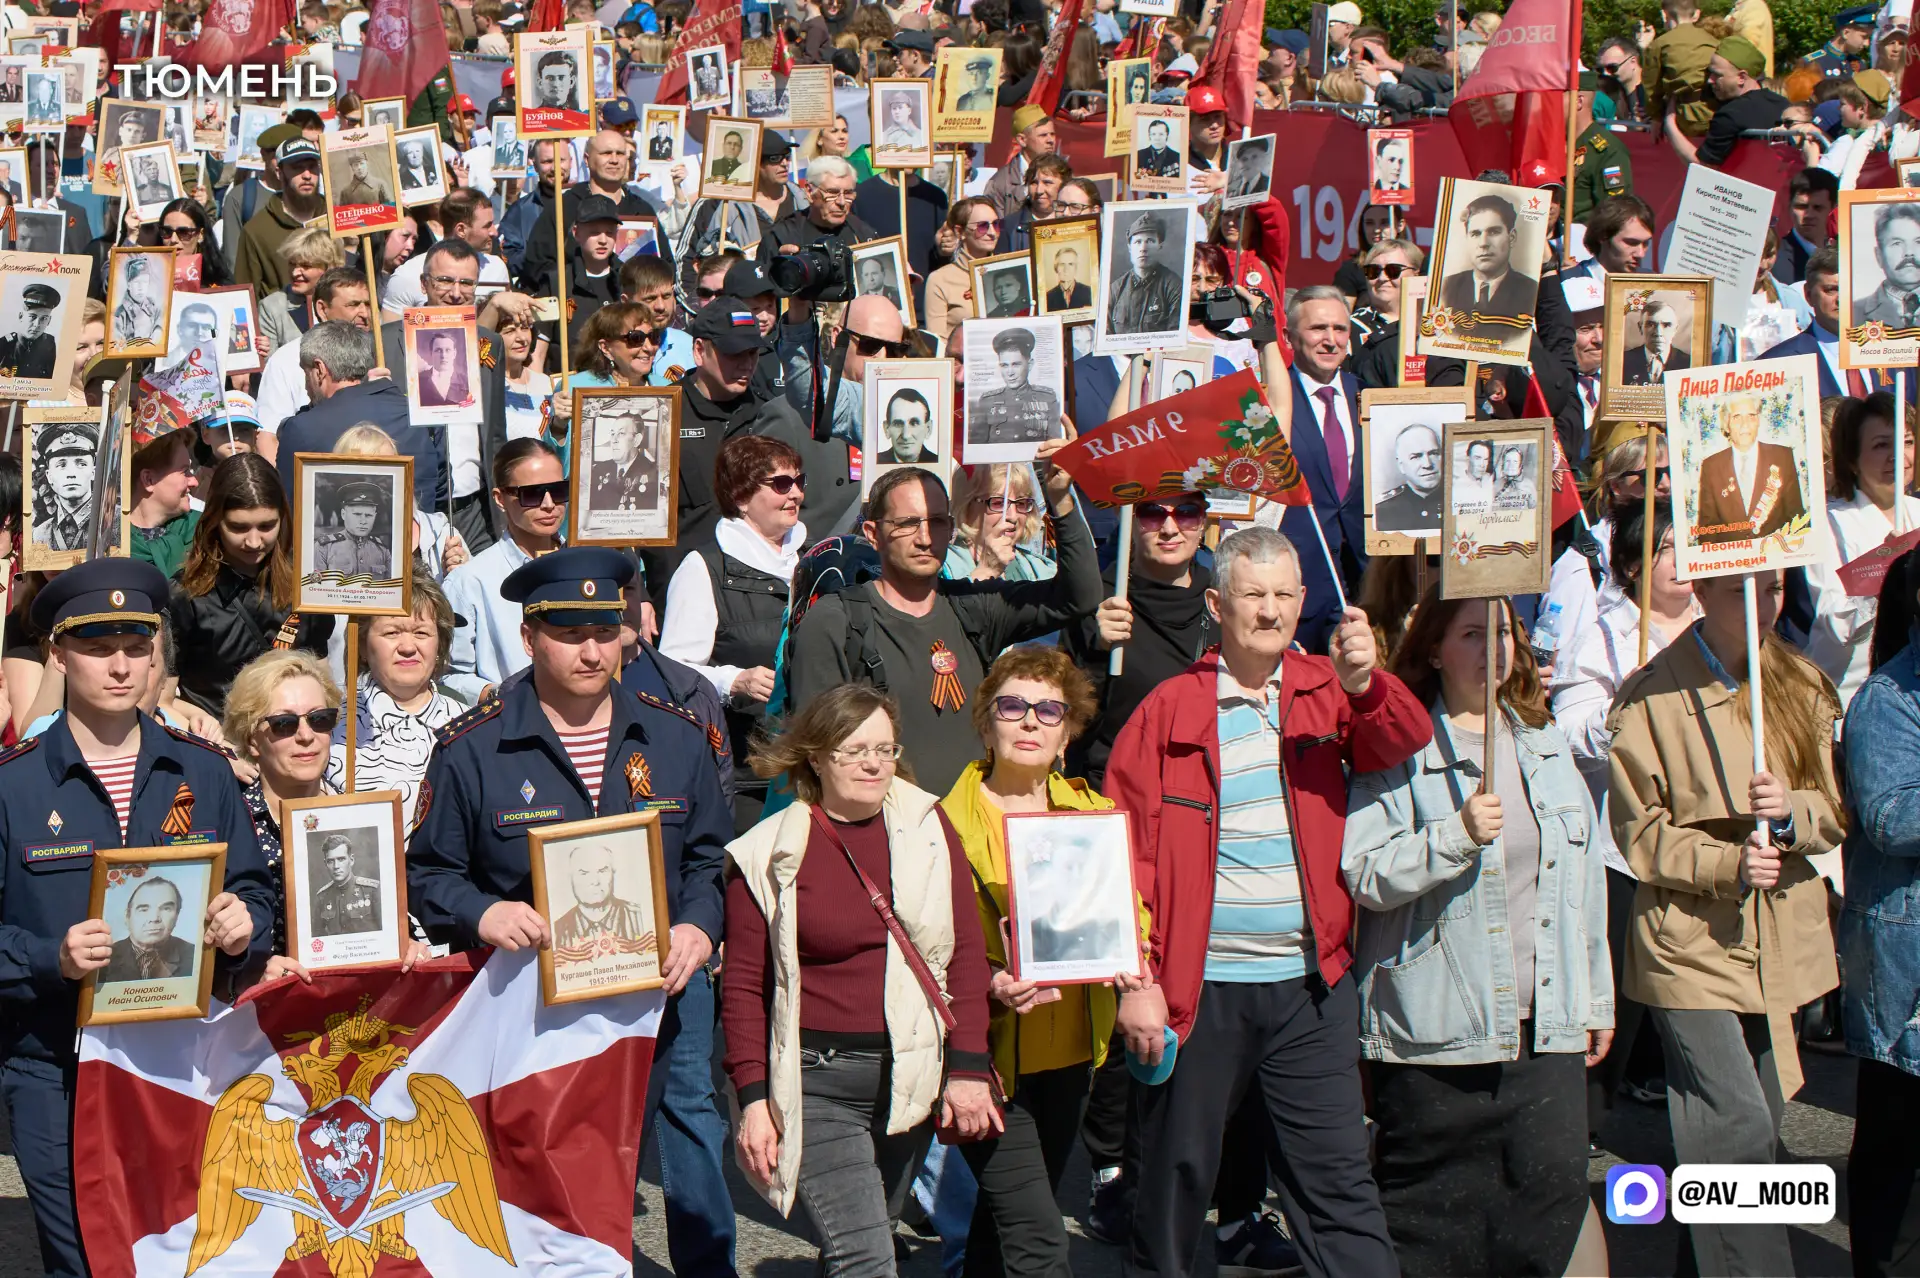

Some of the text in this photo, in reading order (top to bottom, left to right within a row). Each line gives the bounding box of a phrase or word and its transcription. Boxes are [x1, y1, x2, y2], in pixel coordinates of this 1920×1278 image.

[525, 112, 563, 120] БУЯНОВ
[1713, 184, 1743, 200] ИВАНОВ
[1695, 187, 1757, 214] Кирилл Матвеевич
[335, 204, 384, 220] СТЕЦЕНКО
[59, 267, 81, 275] ПОЛК
[1678, 369, 1785, 399] Лица Победы
[1701, 539, 1753, 553] Леонид
[503, 809, 558, 821] РОСГВАРДИЯ
[32, 845, 88, 857] РОСГВАРДИЯ
[593, 967, 614, 976] Павел
[615, 960, 656, 971] Михайлович
[123, 986, 164, 995] Конюхов
[107, 993, 178, 1005] Иван Осипович
